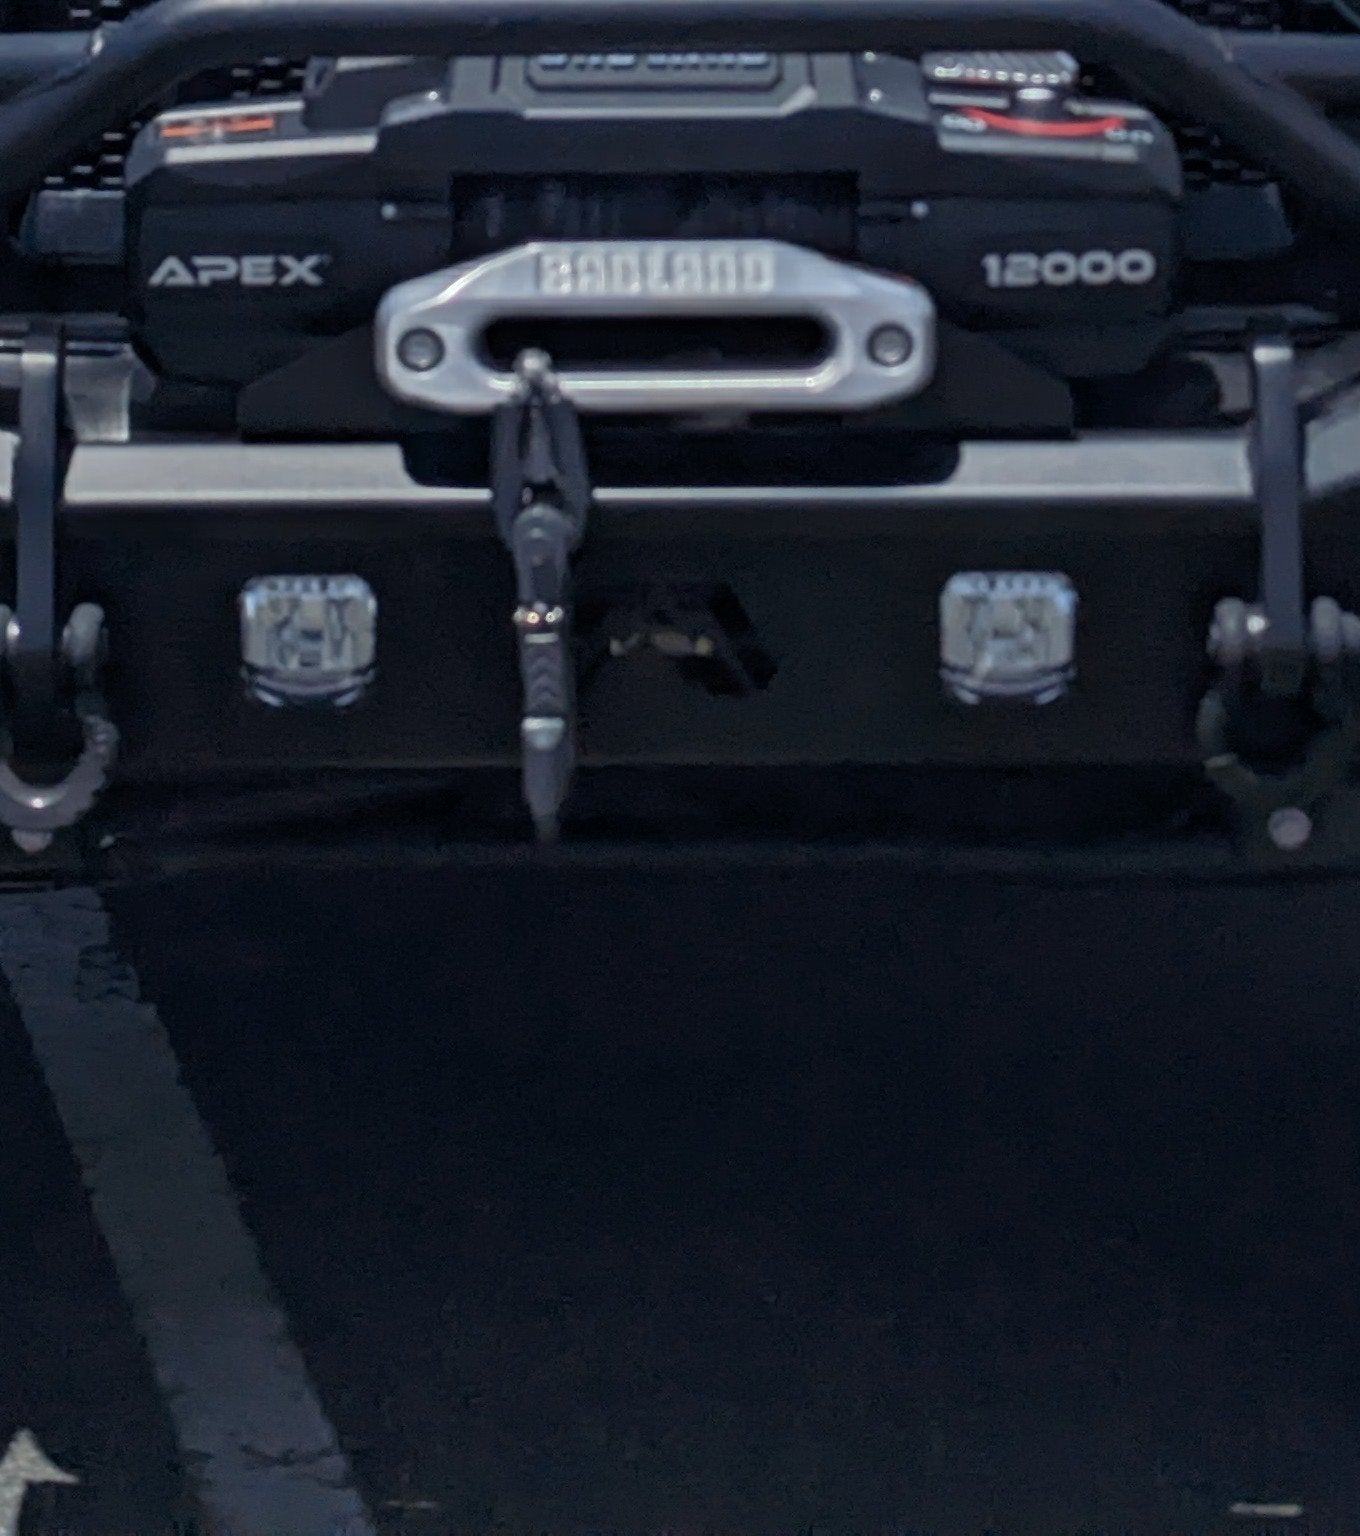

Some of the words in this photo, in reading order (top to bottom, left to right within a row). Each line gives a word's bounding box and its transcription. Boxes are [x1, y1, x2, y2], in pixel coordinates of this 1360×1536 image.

[148, 255, 324, 286] APEX
[539, 249, 776, 293] BADLAND
[981, 249, 1156, 287] 12000
